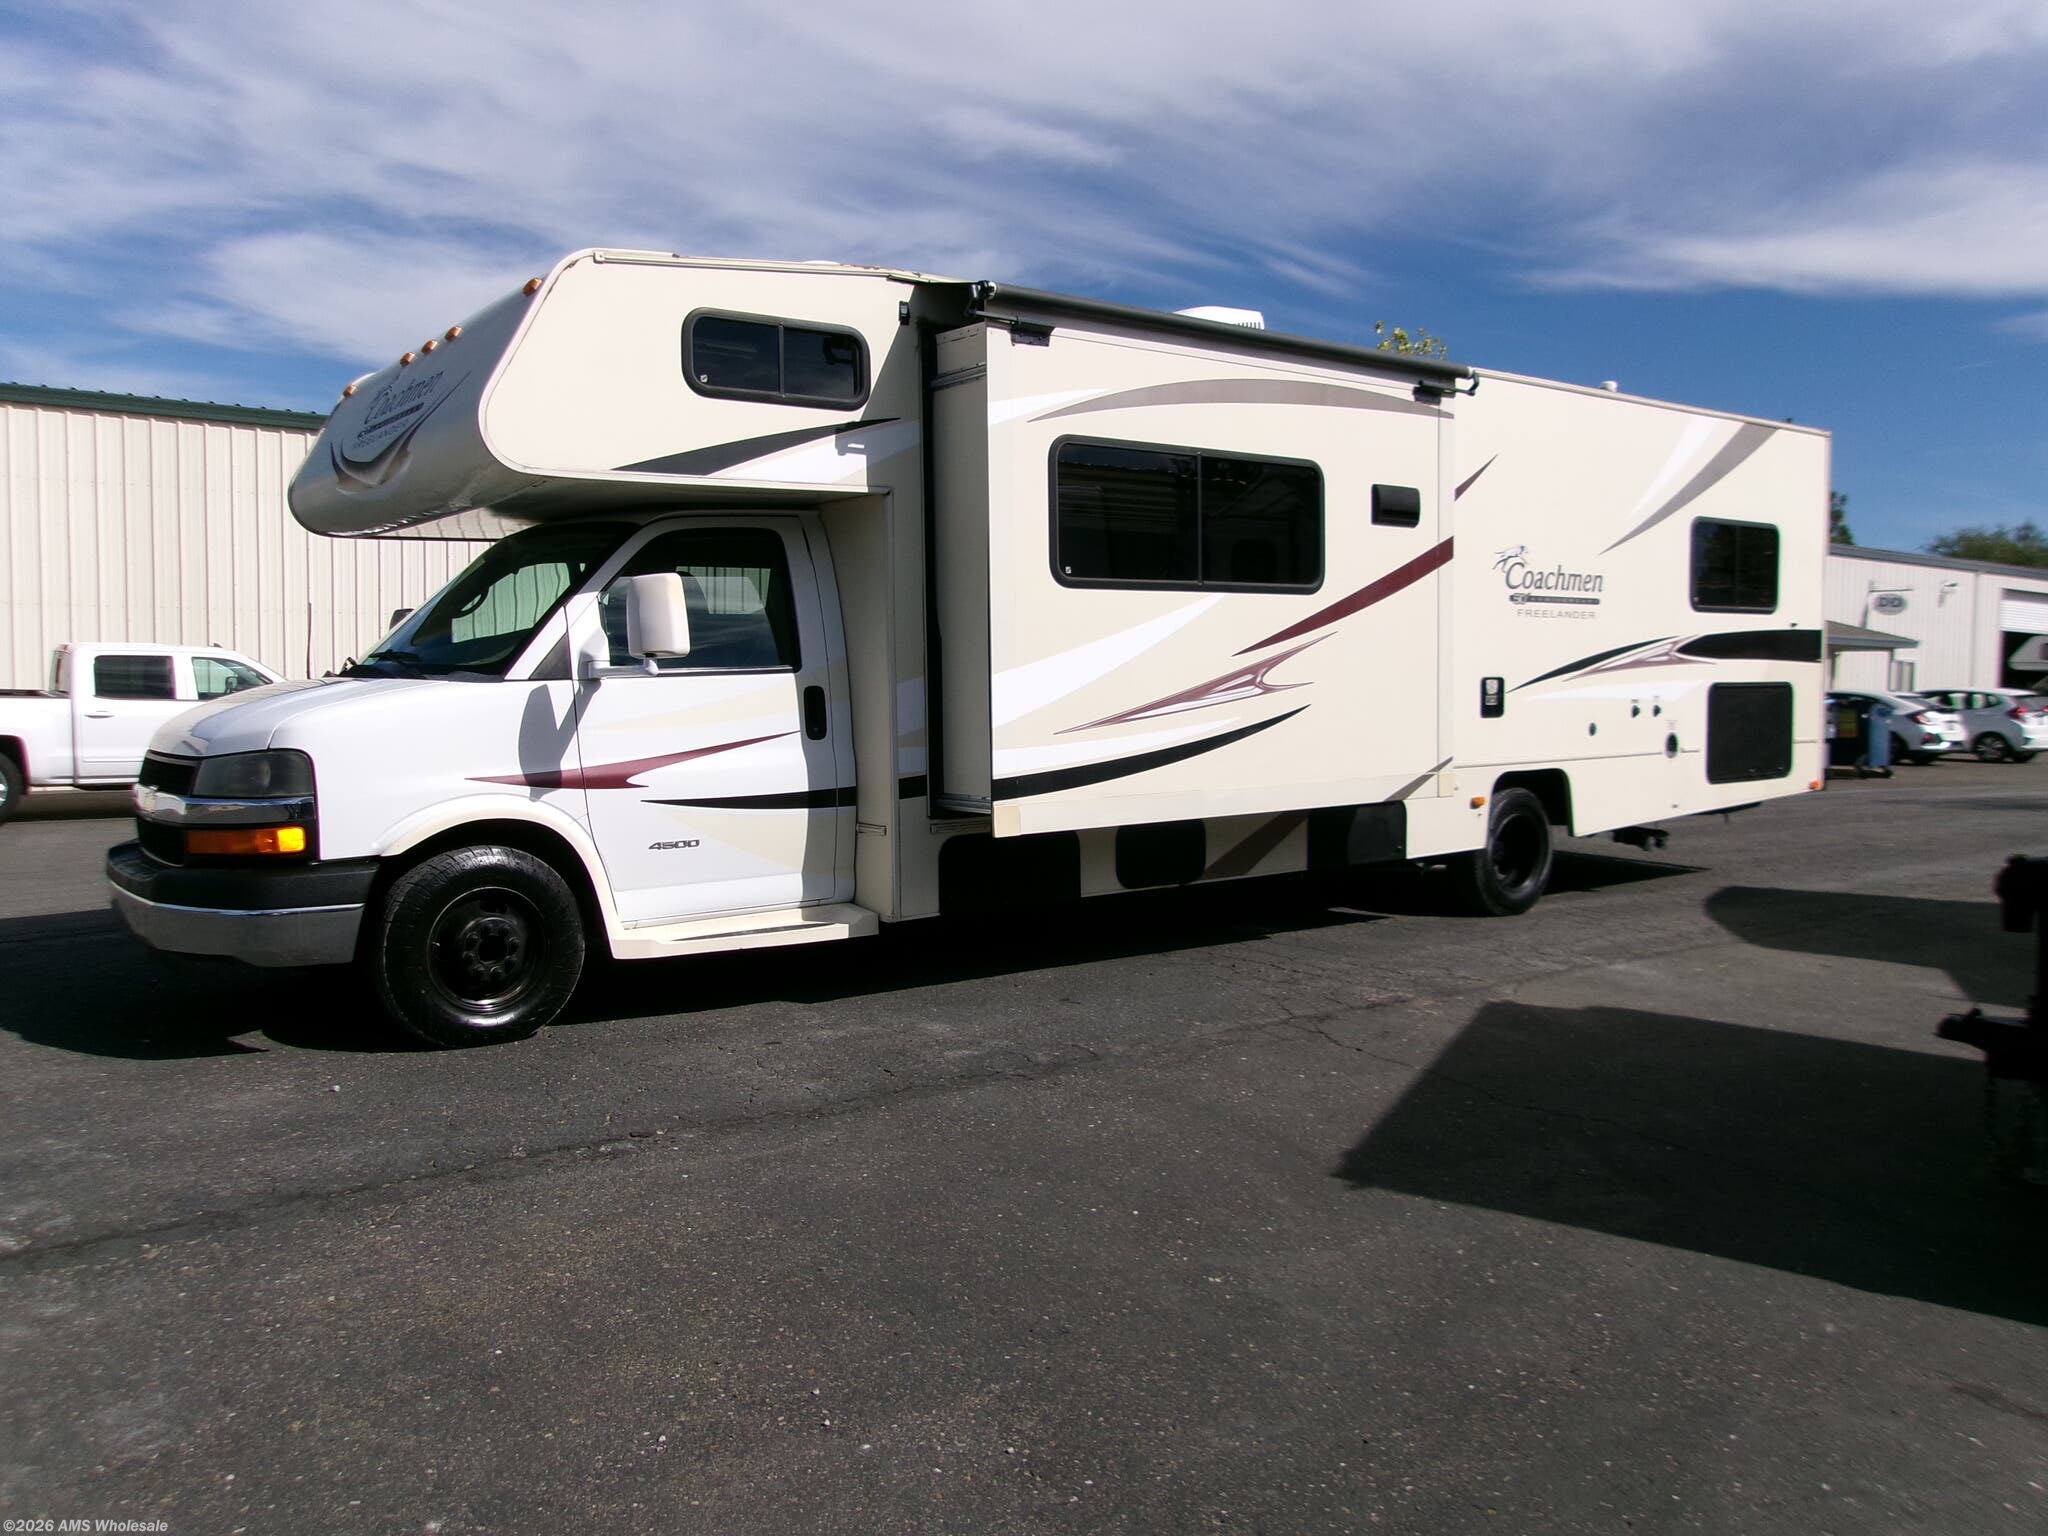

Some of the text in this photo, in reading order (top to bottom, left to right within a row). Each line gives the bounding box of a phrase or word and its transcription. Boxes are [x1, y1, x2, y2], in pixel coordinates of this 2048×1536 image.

[1505, 562, 1603, 592] Coachmen
[1517, 608, 1596, 619] FREELANDER
[648, 839, 700, 850] 4500
